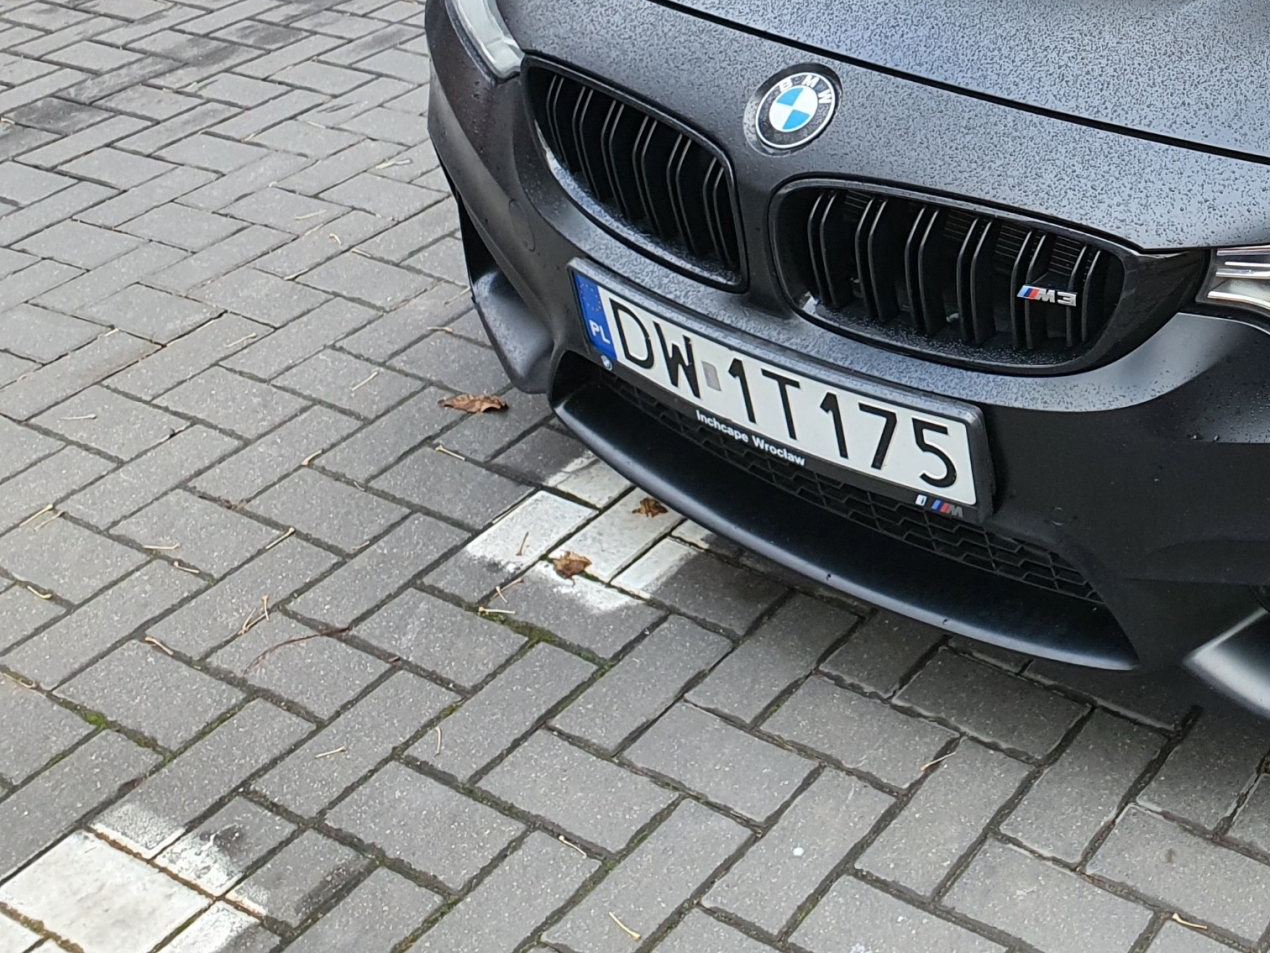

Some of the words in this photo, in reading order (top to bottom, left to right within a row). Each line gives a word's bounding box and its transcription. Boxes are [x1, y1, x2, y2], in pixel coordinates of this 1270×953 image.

[779, 74, 832, 104] BMW
[1034, 288, 1077, 307] M3
[589, 319, 611, 345] PL
[608, 297, 702, 400] DW
[728, 358, 957, 489] 1T175
[696, 409, 749, 443] Inchcape
